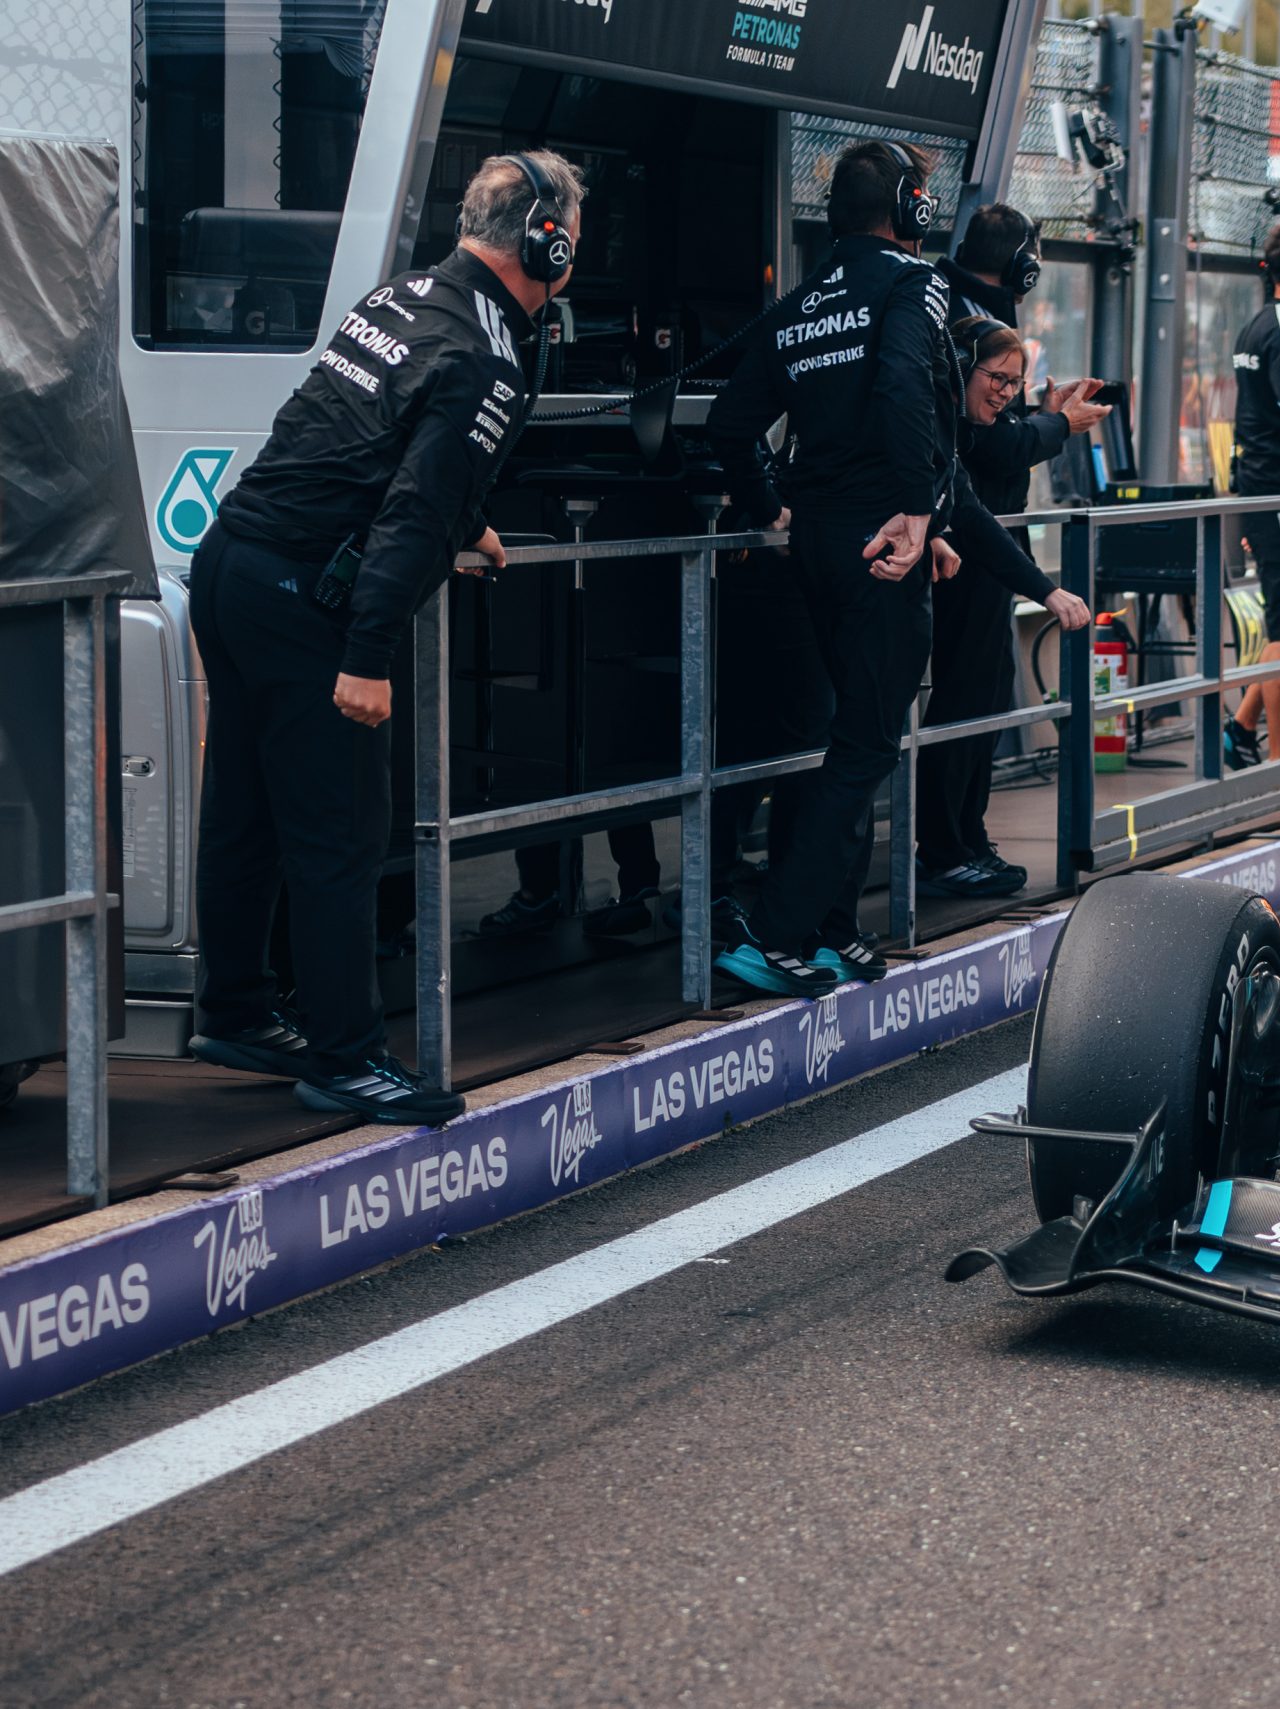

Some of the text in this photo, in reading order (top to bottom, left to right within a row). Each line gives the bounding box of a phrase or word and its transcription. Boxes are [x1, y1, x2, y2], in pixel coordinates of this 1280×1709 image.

[726, 45, 796, 72] FORMULA 1 TEAM
[732, 11, 802, 50] PETRONAS
[922, 31, 985, 96] Nasdaq
[340, 311, 410, 366] TRONAS
[776, 306, 871, 350] PETRONAS
[320, 350, 380, 394] OWDSTRIKE
[869, 964, 981, 1041] LAS VEGAS
[798, 1011, 846, 1085] Vegas
[573, 1081, 592, 1117] LAS
[633, 1038, 775, 1134] LAS VEGAS
[541, 1099, 602, 1187] Vegas
[238, 1190, 263, 1233] LAS
[319, 1135, 508, 1249] LAS VEGAS
[194, 1204, 278, 1317] Vegas
[0, 1262, 150, 1370] VEGAS
